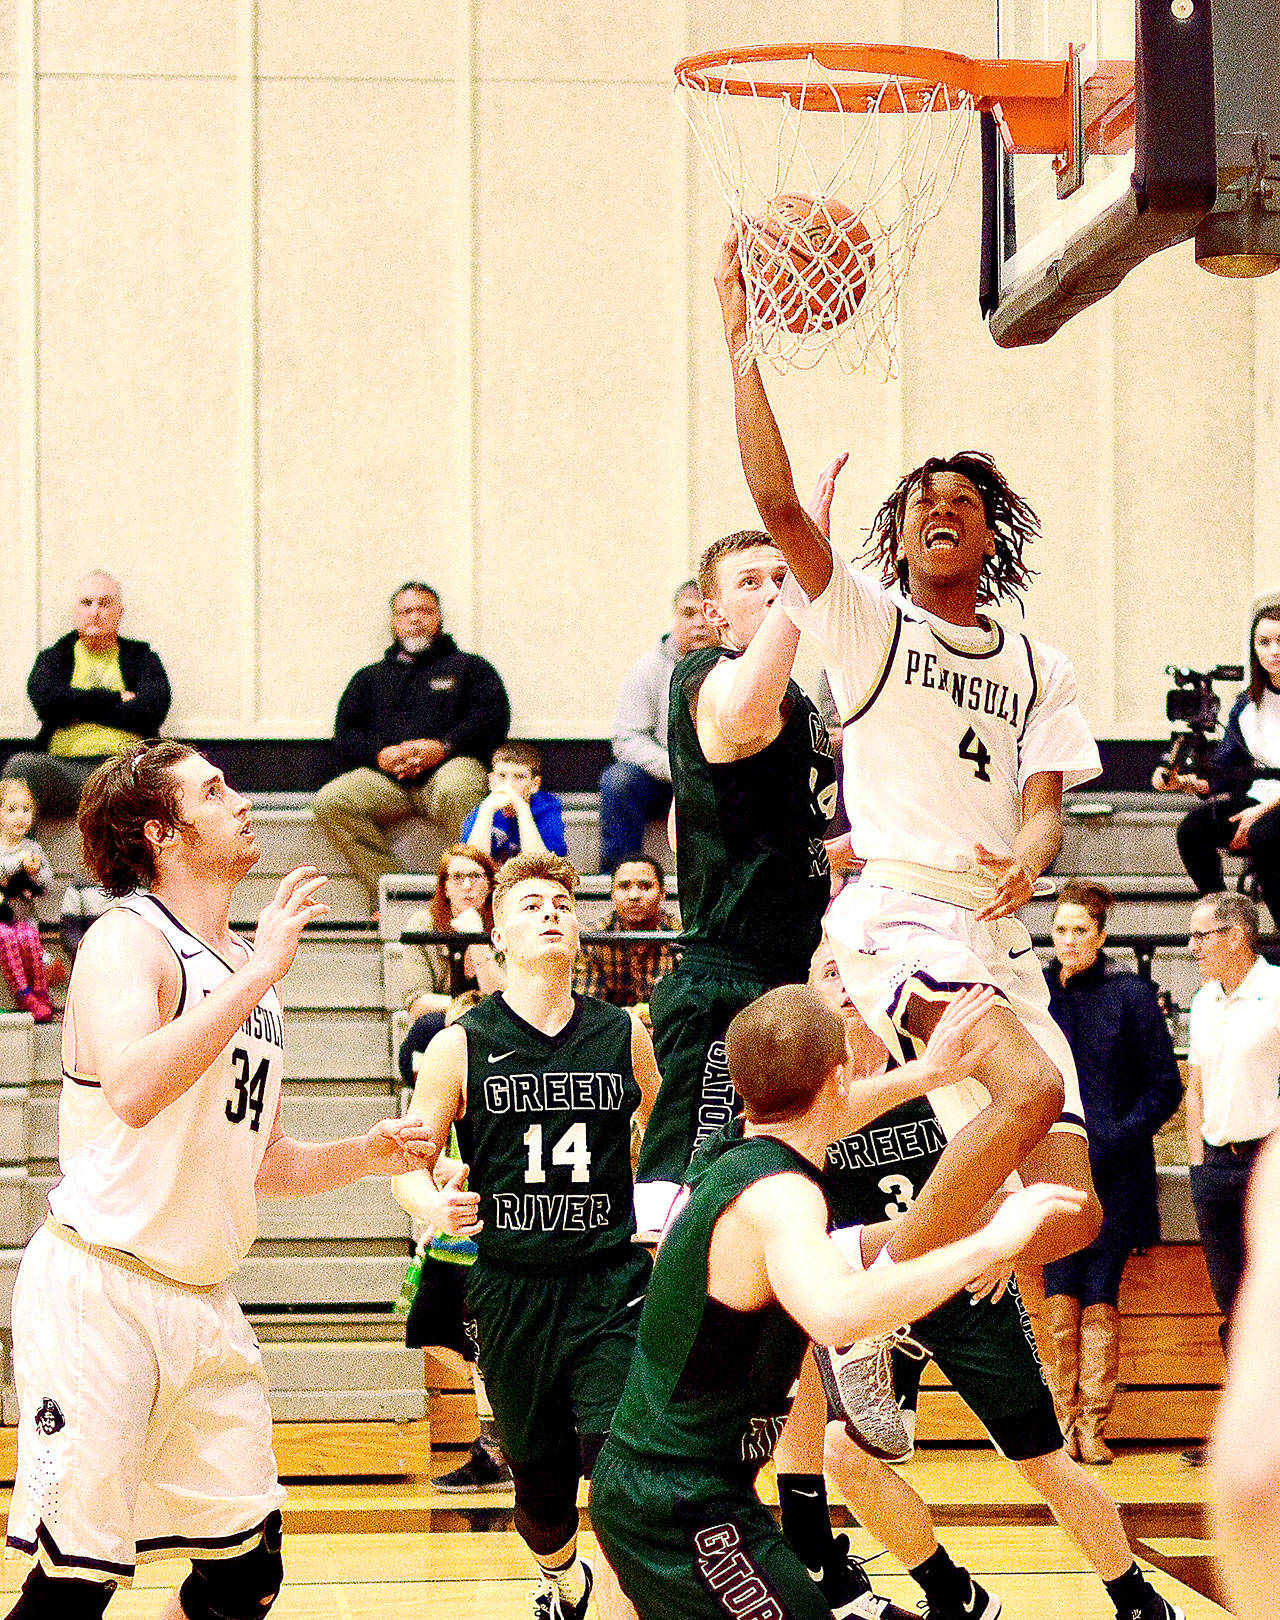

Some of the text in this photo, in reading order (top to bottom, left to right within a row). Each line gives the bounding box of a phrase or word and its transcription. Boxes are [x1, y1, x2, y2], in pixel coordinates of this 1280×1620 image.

[958, 725, 991, 782] 4
[224, 1047, 270, 1133] 34
[483, 1072, 624, 1114] GREEN
[523, 1122, 591, 1183] 14
[493, 1193, 611, 1231] RIVER
